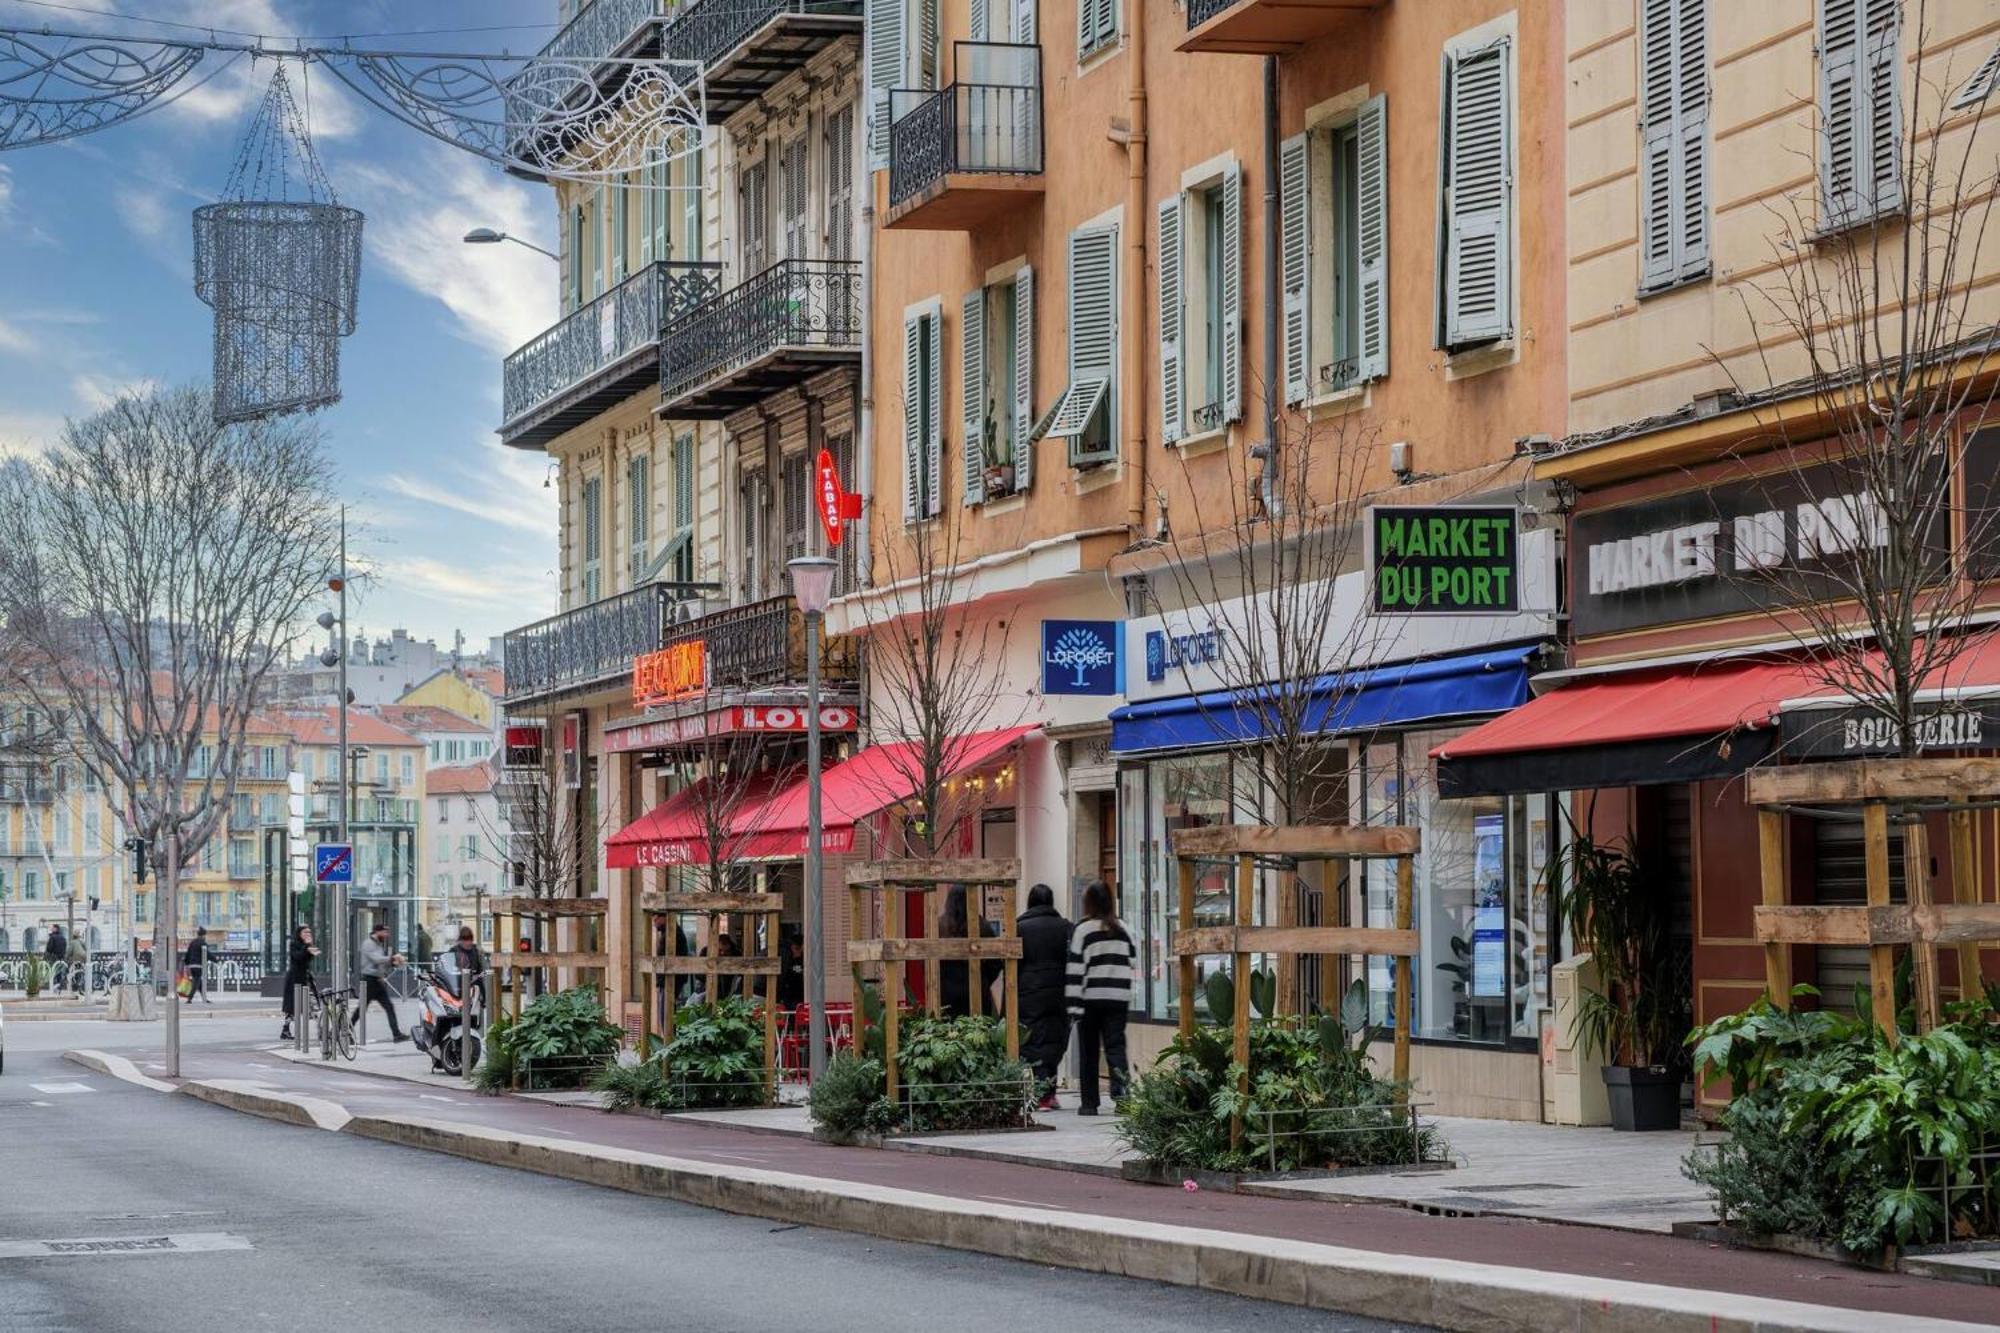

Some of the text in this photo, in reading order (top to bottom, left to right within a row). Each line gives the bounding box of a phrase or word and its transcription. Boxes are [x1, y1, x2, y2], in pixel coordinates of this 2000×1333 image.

[822, 468, 838, 527] TABAC
[1380, 518, 1511, 557] MARKET
[1588, 521, 1720, 595] MARKET
[1734, 511, 1786, 571] DU
[1381, 566, 1511, 605] DU PORT
[743, 707, 849, 729] LOTO
[636, 842, 691, 864] LE CASSINI
